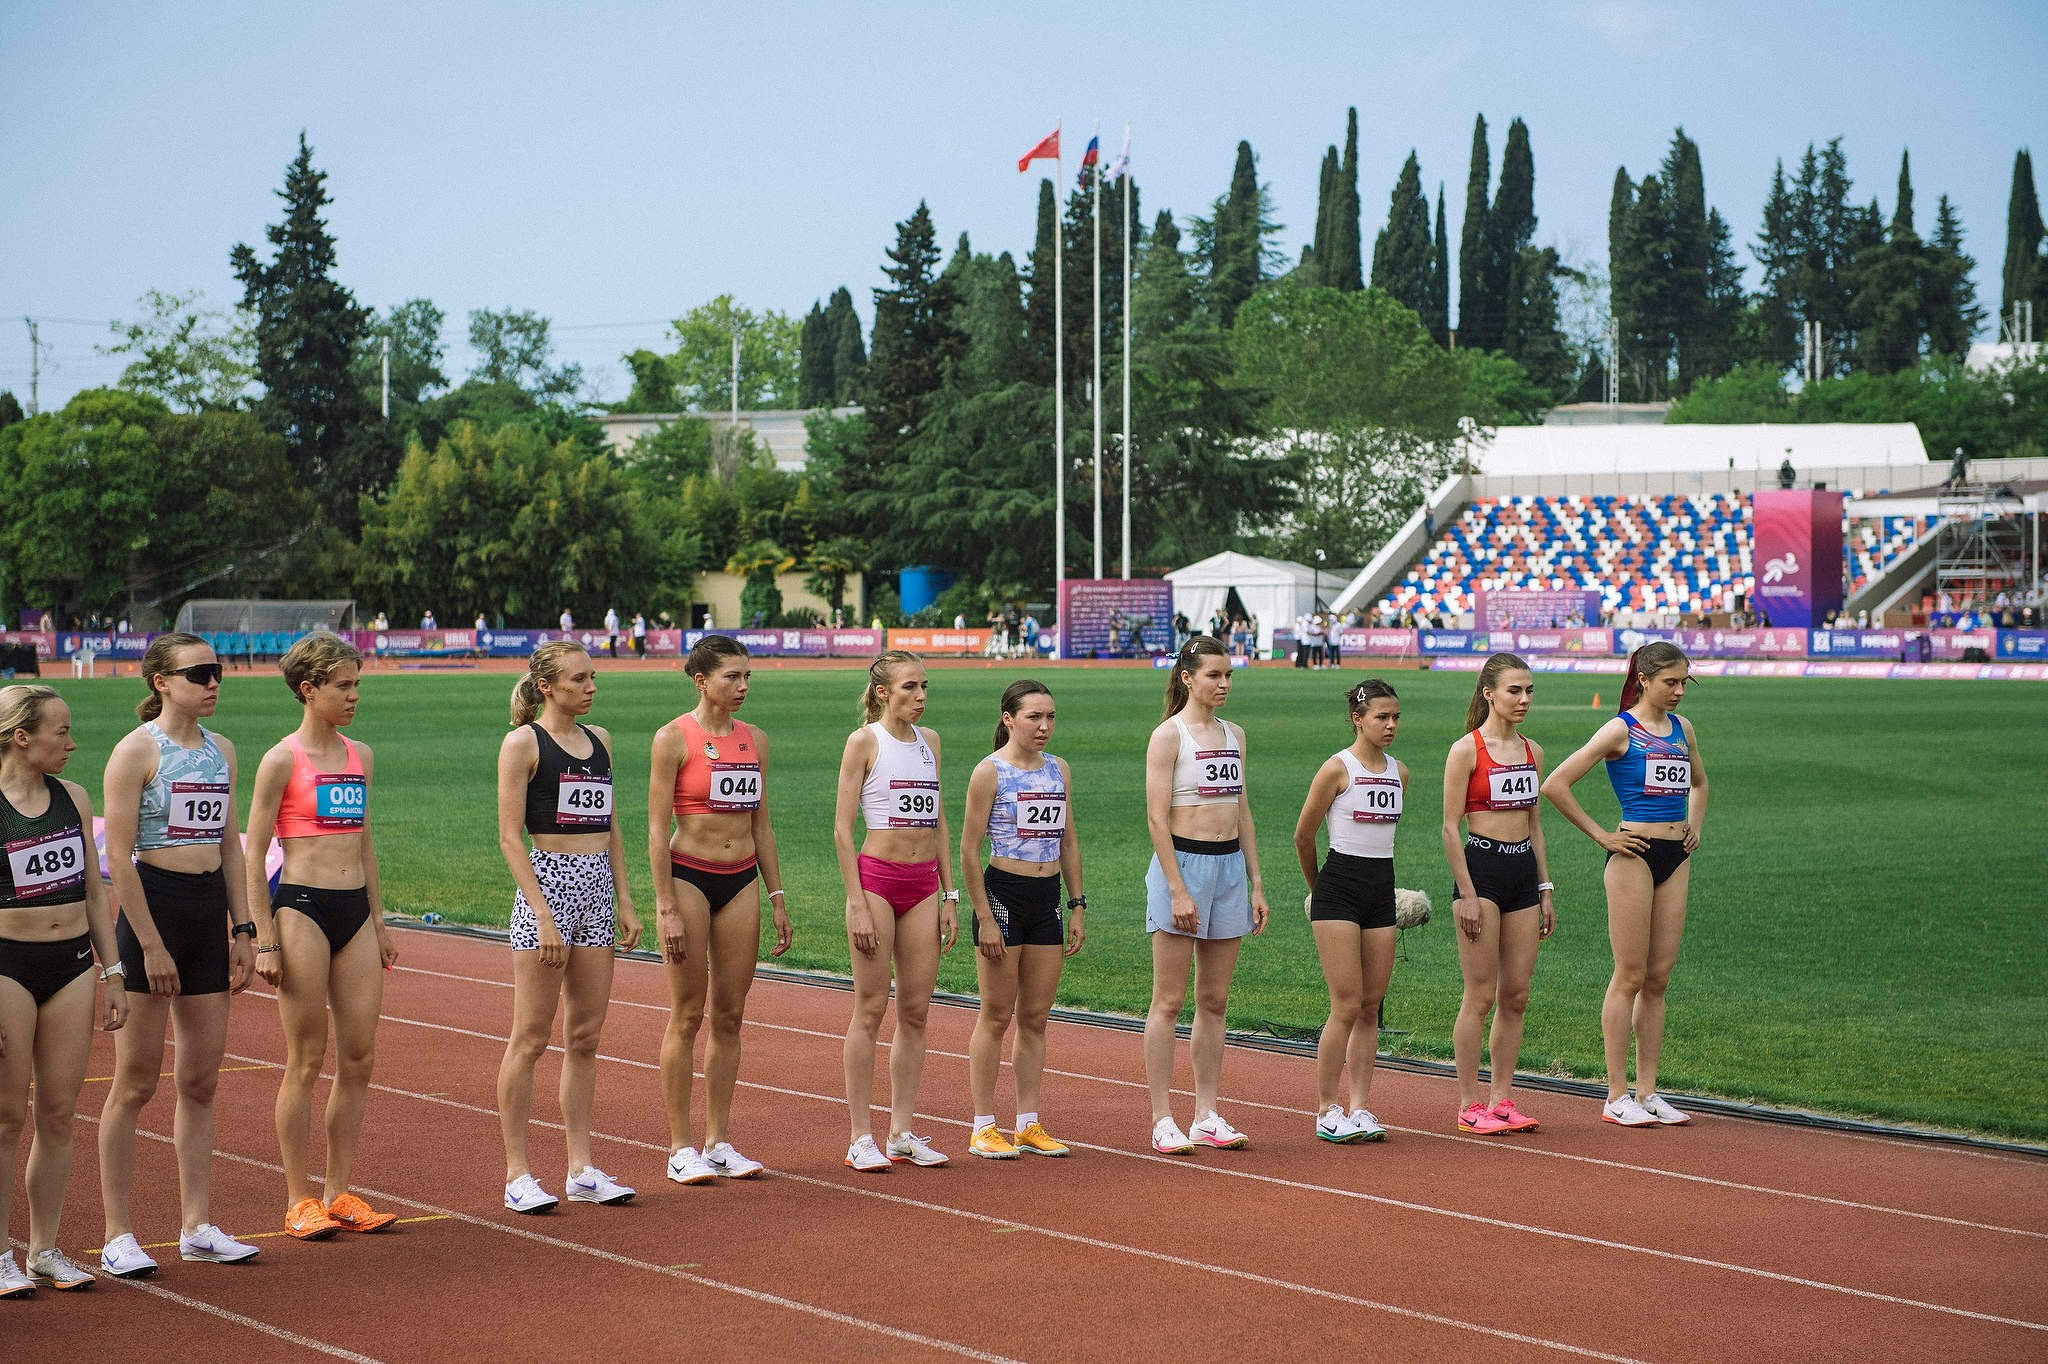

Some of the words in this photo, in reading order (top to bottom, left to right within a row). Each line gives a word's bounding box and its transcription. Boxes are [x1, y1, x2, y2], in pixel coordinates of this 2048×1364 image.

[116, 637, 148, 650] FONB
[1205, 763, 1239, 781] 340
[1654, 765, 1686, 783] 562
[719, 777, 758, 796] 044
[1501, 776, 1532, 794] 441
[329, 786, 363, 805] 003
[567, 789, 605, 809] 438
[898, 794, 934, 813] 399
[1366, 790, 1395, 809] 101
[184, 800, 222, 822] 192
[1027, 806, 1061, 824] 247
[1467, 835, 1492, 849] PRO
[1497, 842, 1527, 854] NIKE
[25, 846, 76, 876] 489
